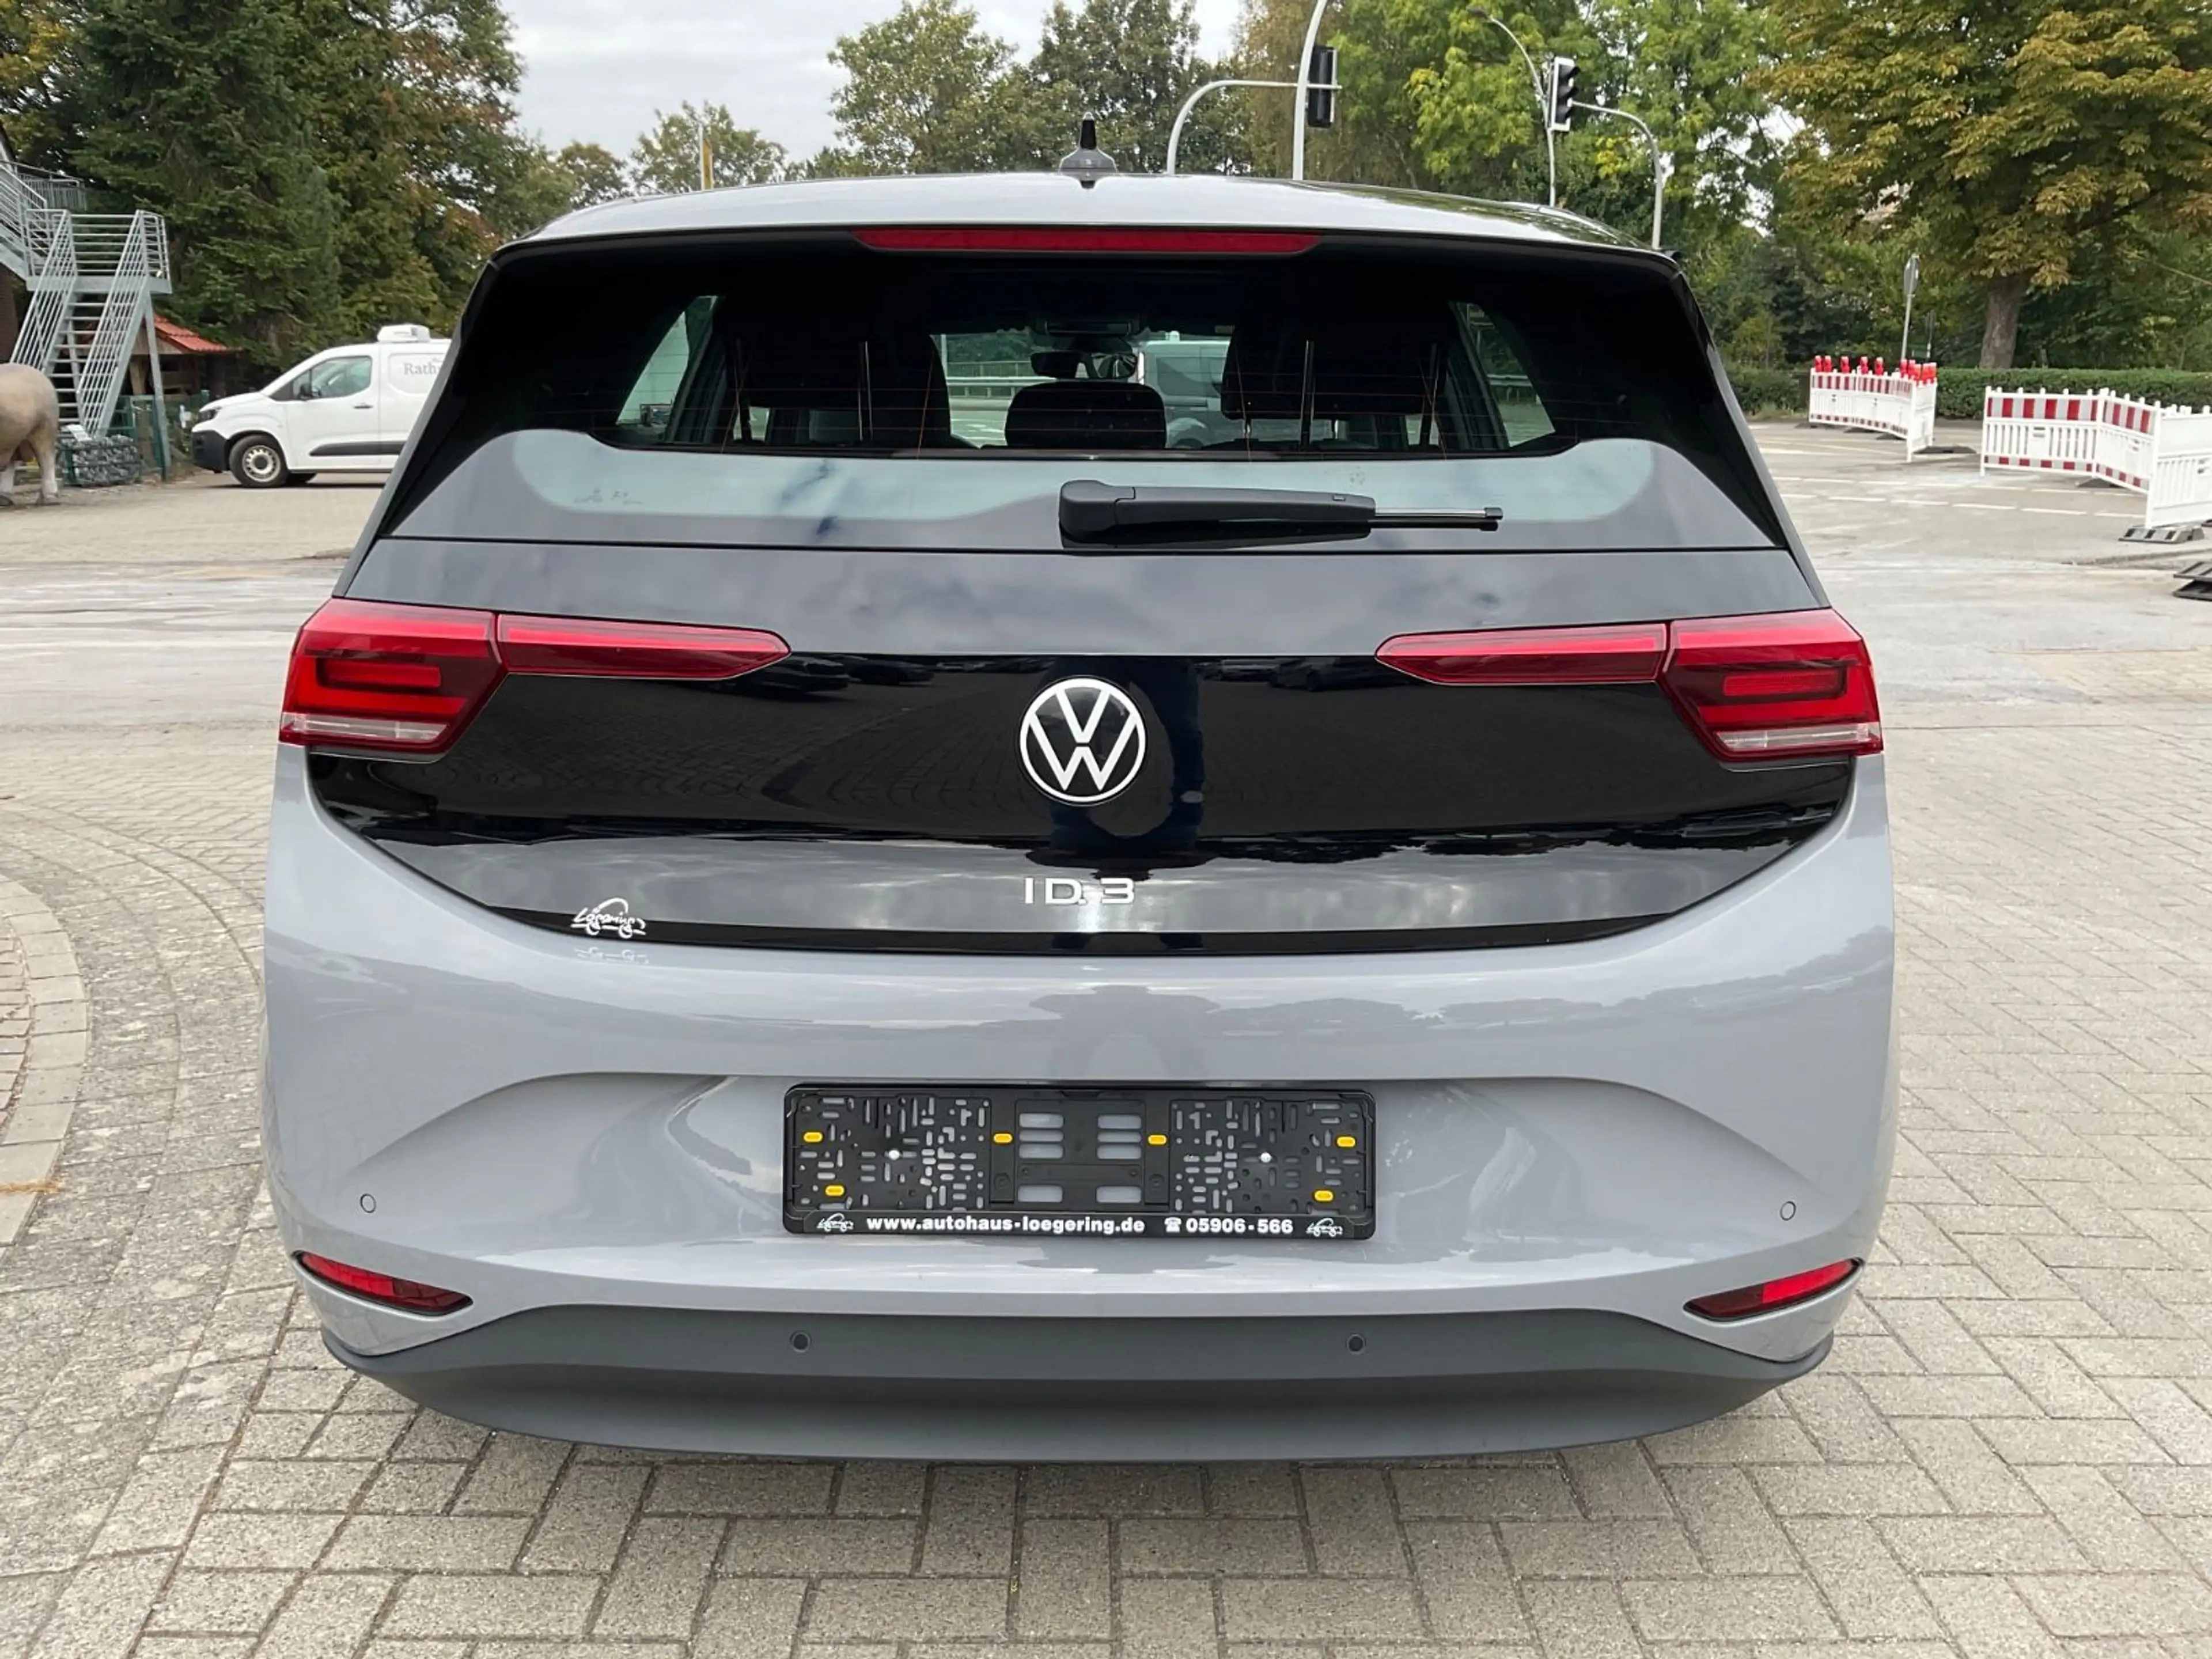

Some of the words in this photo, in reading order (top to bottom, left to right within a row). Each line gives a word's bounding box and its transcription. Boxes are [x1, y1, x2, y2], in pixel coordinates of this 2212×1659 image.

[404, 361, 441, 376] Rath
[1025, 684, 1141, 795] VW
[867, 1215, 1145, 1234] www.autohaus-loegering.de
